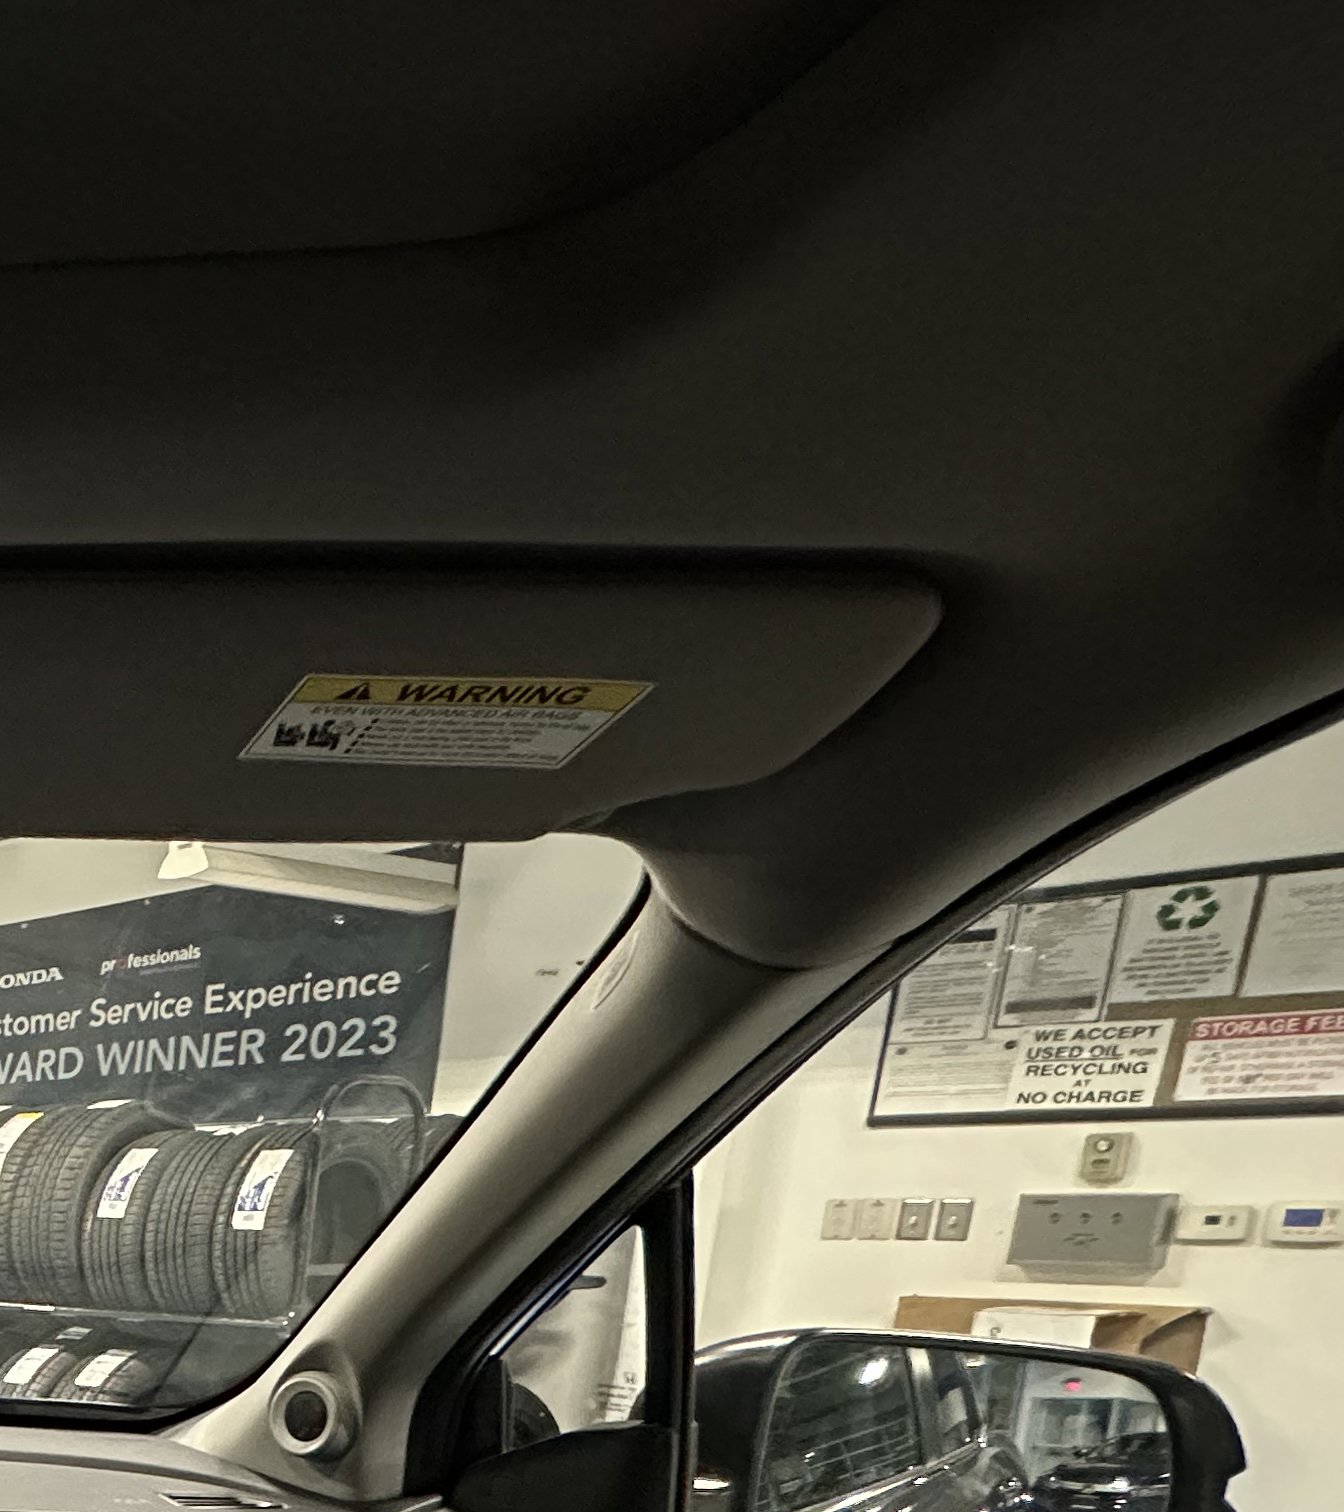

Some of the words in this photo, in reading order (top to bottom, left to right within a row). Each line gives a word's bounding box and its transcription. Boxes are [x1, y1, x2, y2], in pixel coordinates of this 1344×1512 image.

[397, 684, 591, 704] WARNING
[100, 944, 202, 976] professionals
[89, 991, 193, 1028] Service
[204, 970, 402, 1020] Experience
[1035, 1029, 1067, 1042] WE
[1071, 1025, 1161, 1041] ACCEPT
[1194, 1016, 1301, 1038] STORAGE
[95, 1028, 266, 1077] WINNER
[280, 1014, 398, 1062] 2023
[1026, 1046, 1083, 1060] USED
[1089, 1044, 1124, 1058] OIL
[1025, 1061, 1149, 1076] RECYCLING
[1072, 1079, 1093, 1088] AT
[1016, 1091, 1048, 1104] NO
[1053, 1090, 1145, 1104] CHARGE
